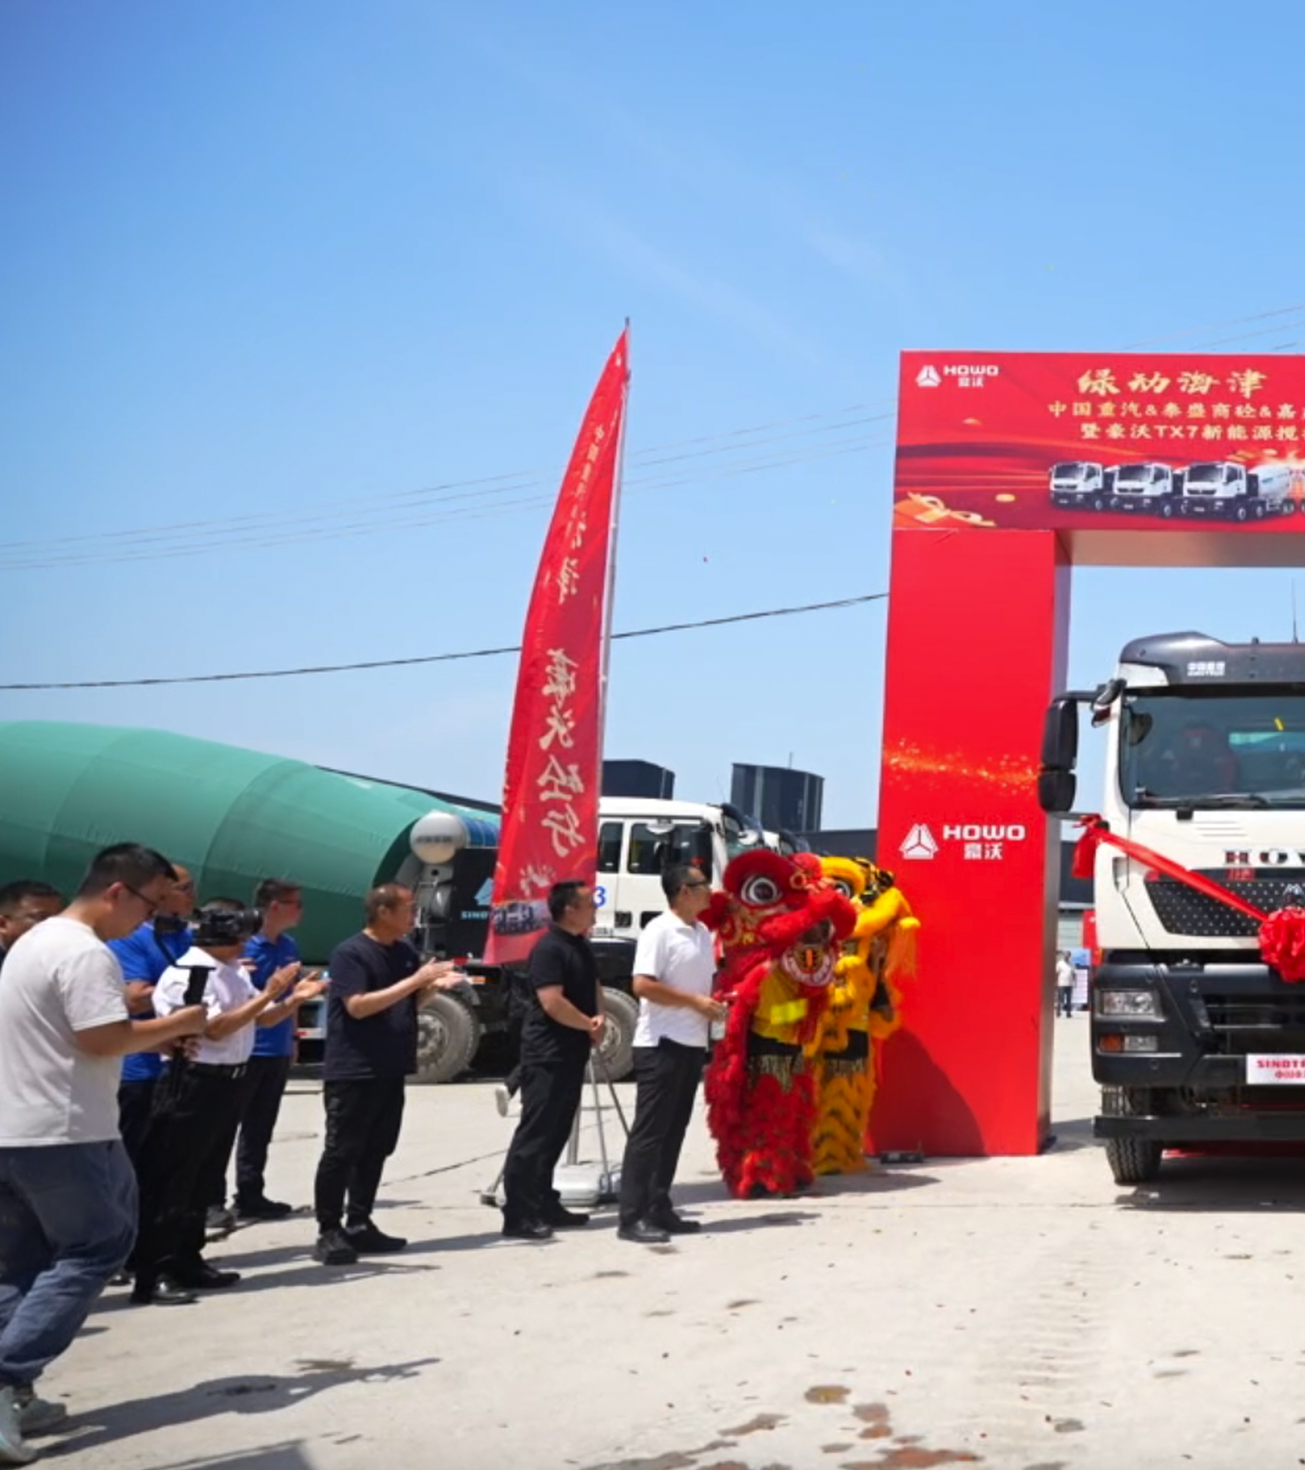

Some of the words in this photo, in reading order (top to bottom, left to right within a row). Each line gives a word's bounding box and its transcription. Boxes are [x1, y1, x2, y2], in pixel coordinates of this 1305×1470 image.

[943, 365, 999, 376] HOWO
[942, 824, 1026, 841] HOWO
[963, 842, 1003, 860] 豪沃
